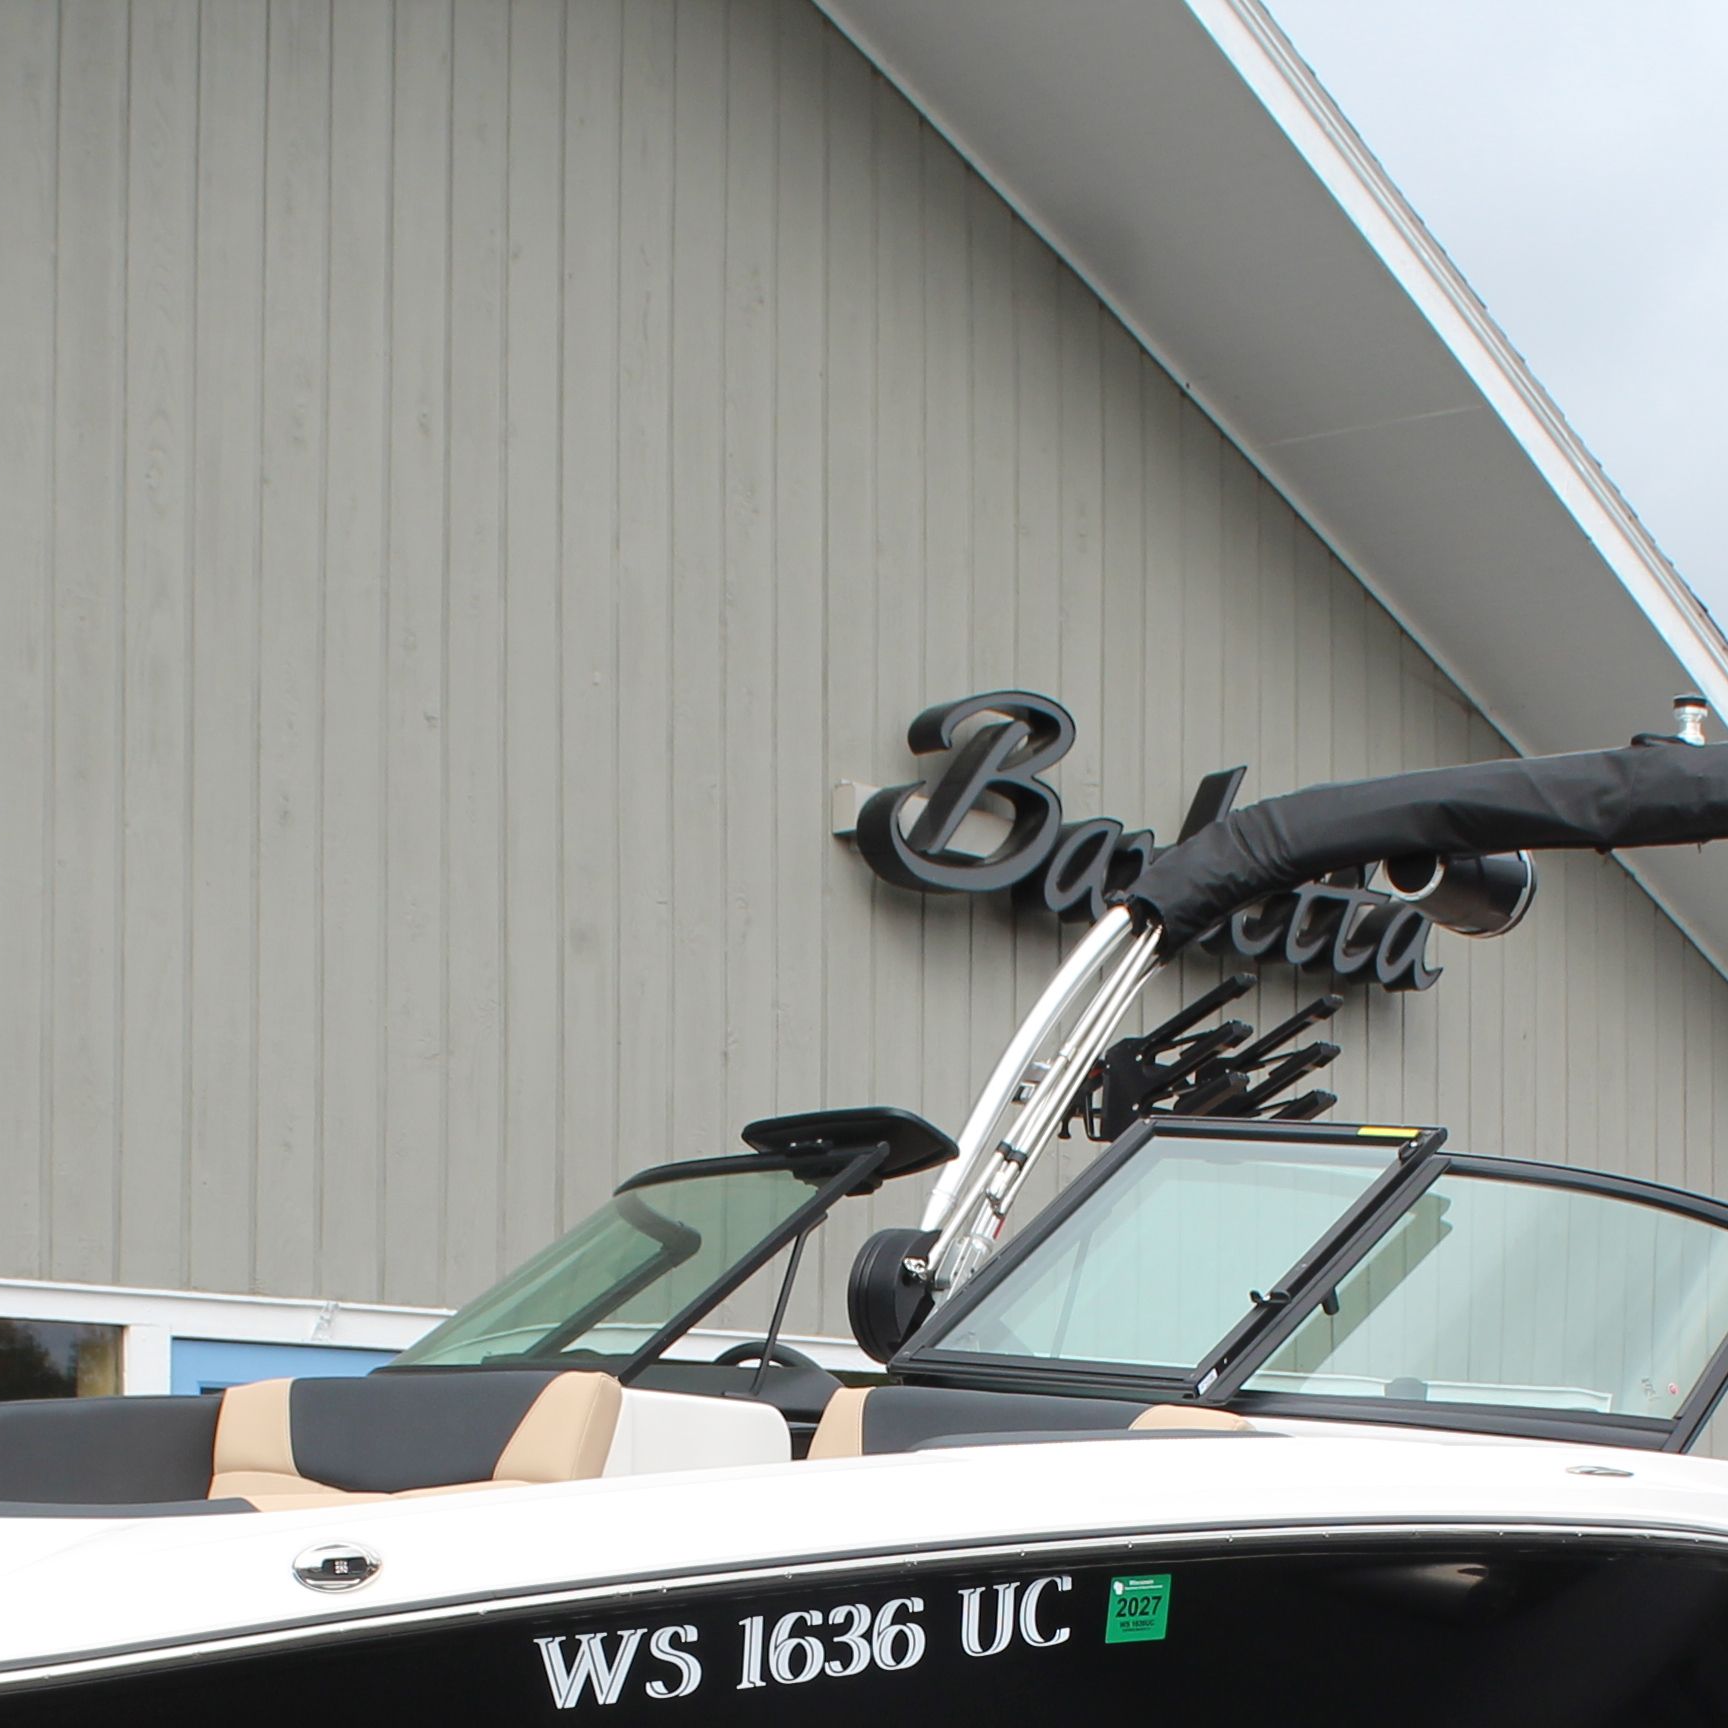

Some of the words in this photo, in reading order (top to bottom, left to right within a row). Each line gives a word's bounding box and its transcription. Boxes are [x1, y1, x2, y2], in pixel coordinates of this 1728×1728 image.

[533, 1627, 702, 1710] WS
[736, 1597, 925, 1690] 1636
[958, 1576, 1072, 1658] UC
[1115, 1595, 1163, 1618] 2027
